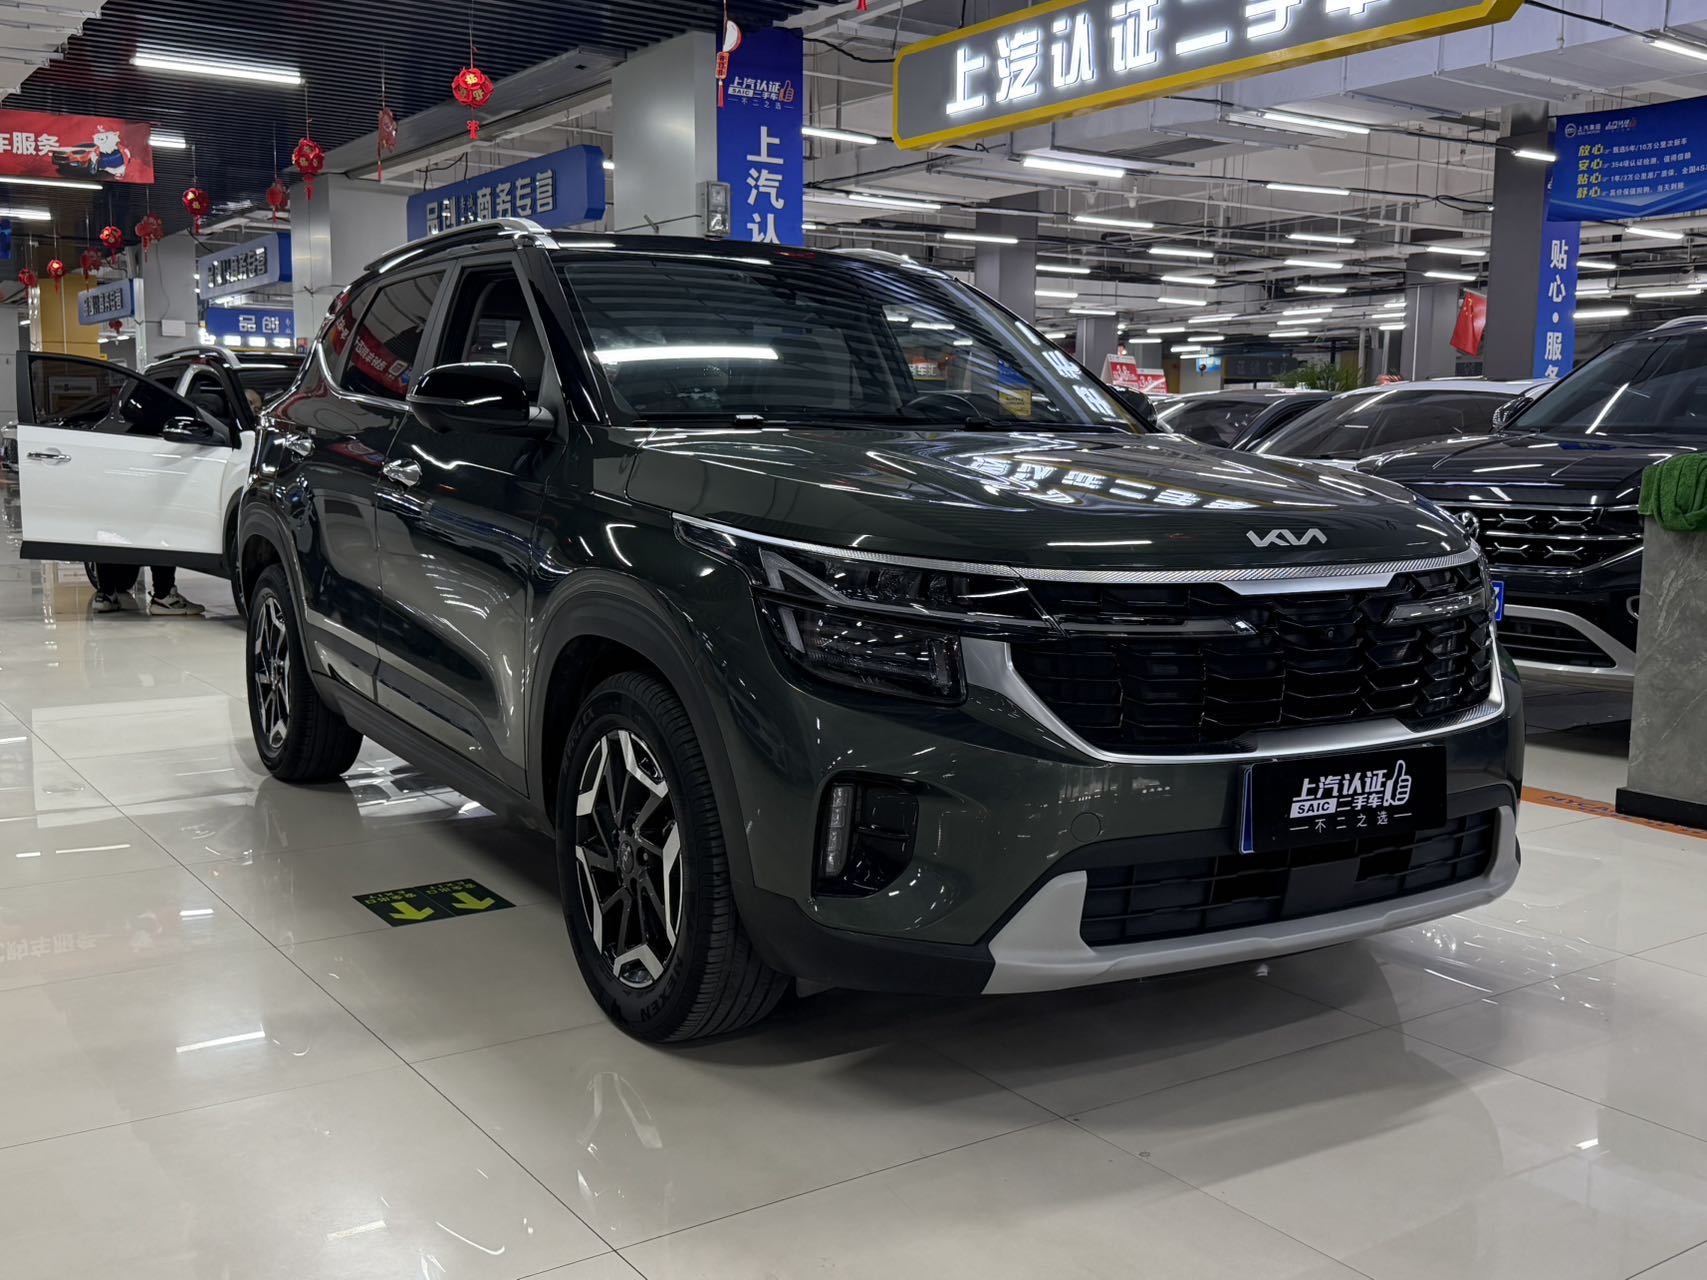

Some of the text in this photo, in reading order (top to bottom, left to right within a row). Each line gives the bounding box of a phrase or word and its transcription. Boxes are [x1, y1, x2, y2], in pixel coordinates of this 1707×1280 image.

[944, 0, 1390, 116] 上汽认证二手
[729, 76, 782, 93] 上汽认证
[732, 88, 779, 101] SAIC 二手车
[746, 126, 785, 244] 上汽认
[1246, 528, 1328, 547] KIA
[1292, 769, 1388, 801] 上汽认证
[1297, 793, 1384, 815] SAIC 二手车
[1315, 810, 1389, 833] 不二之选
